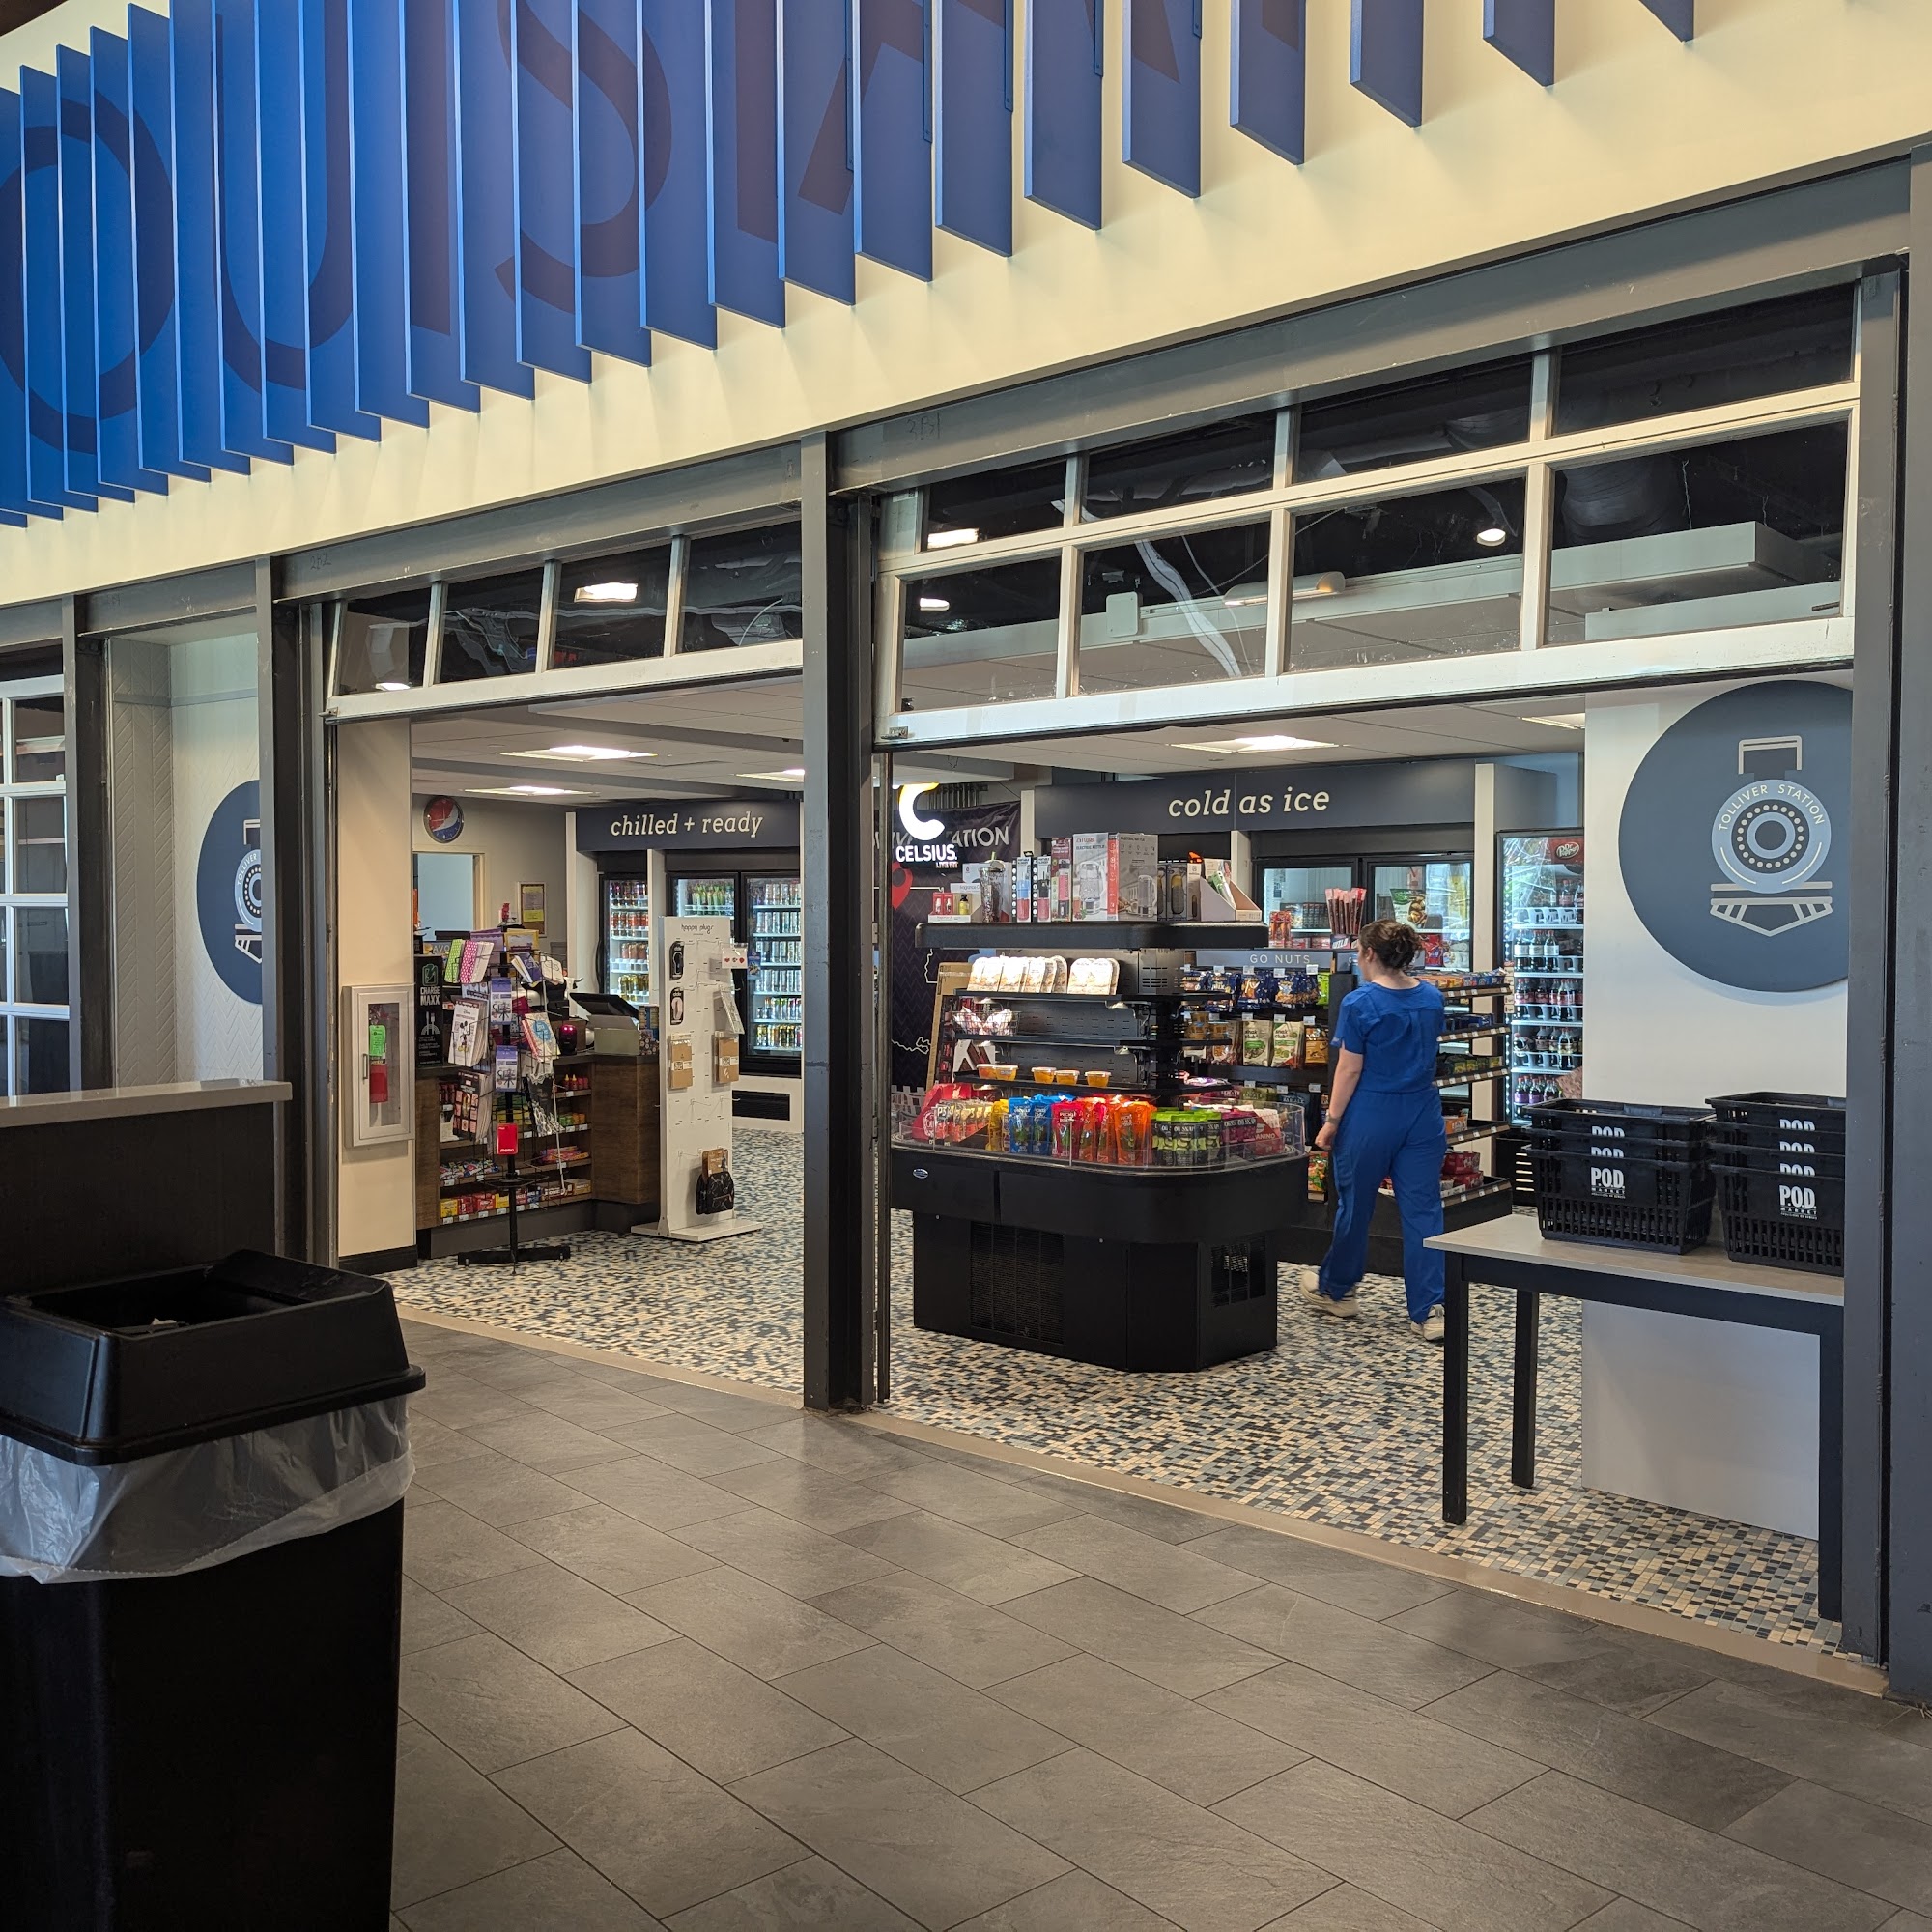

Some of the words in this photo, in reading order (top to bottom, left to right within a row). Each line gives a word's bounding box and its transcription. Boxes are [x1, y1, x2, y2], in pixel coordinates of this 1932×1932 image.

[1168, 789, 1232, 817] cold
[1238, 795, 1273, 814] as
[1283, 786, 1330, 812] ice
[1719, 784, 1768, 831] TOLLIVER
[1777, 784, 1825, 825] STATION
[611, 812, 679, 838] chilled
[683, 817, 696, 832] +
[701, 810, 763, 838] ready
[946, 826, 1009, 847] ATION
[237, 852, 258, 886] TOLLIVER
[1249, 954, 1268, 963] GO
[1275, 954, 1311, 964] NUTS
[420, 986, 440, 995] CHARGE
[420, 994, 440, 1007] MAXX
[1591, 1167, 1625, 1189] P.O.D.
[1779, 1185, 1817, 1209] P.O.D.
